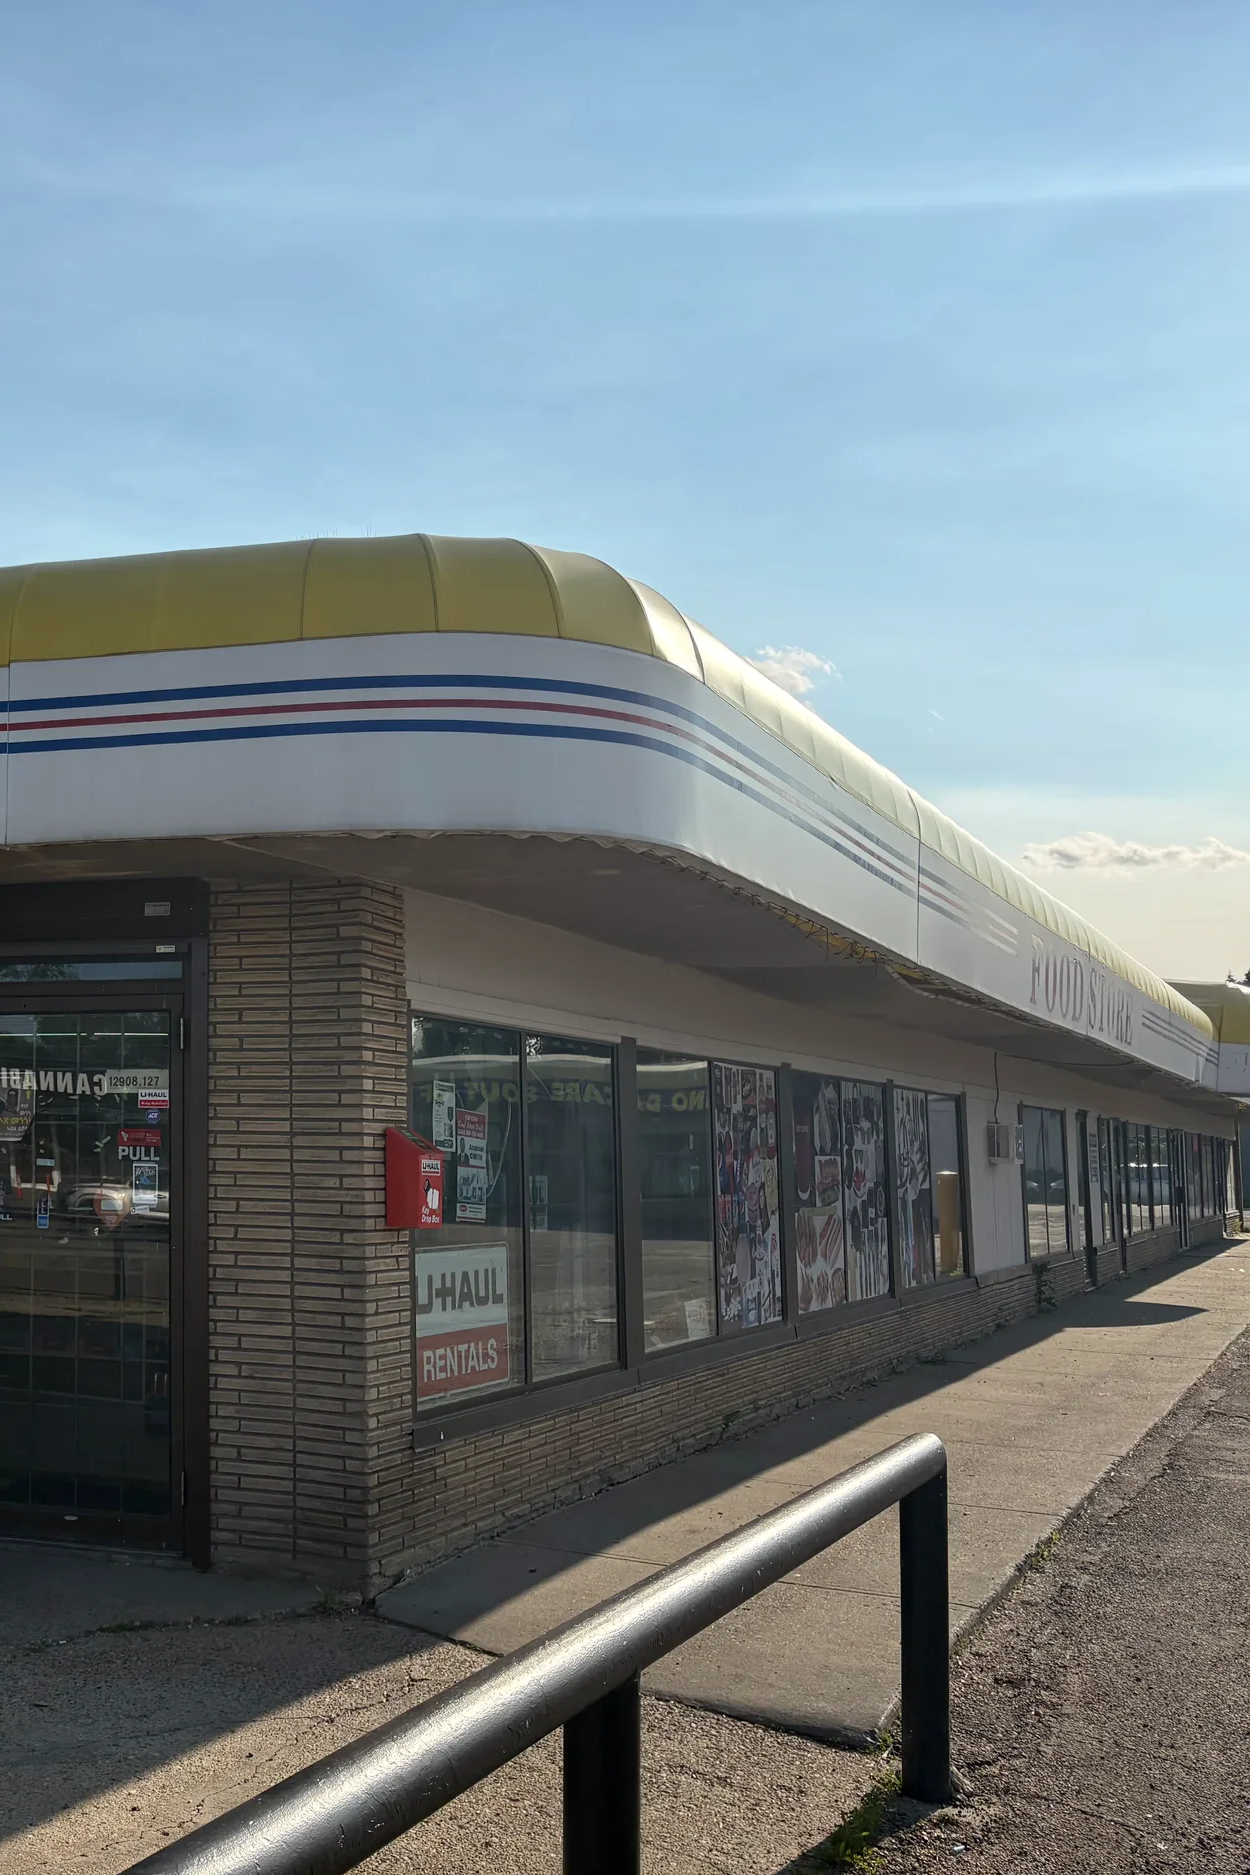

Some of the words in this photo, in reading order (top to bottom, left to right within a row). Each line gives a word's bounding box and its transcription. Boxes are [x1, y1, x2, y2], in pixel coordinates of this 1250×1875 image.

[1030, 933, 1084, 1022] FOOD
[1088, 967, 1133, 1046] STORE
[109, 1076, 160, 1087] 12908.127
[118, 1146, 160, 1161] PULL
[422, 1162, 440, 1170] U-HAUL
[415, 1267, 504, 1315] U-HAUL
[422, 1338, 498, 1383] RENTALS
